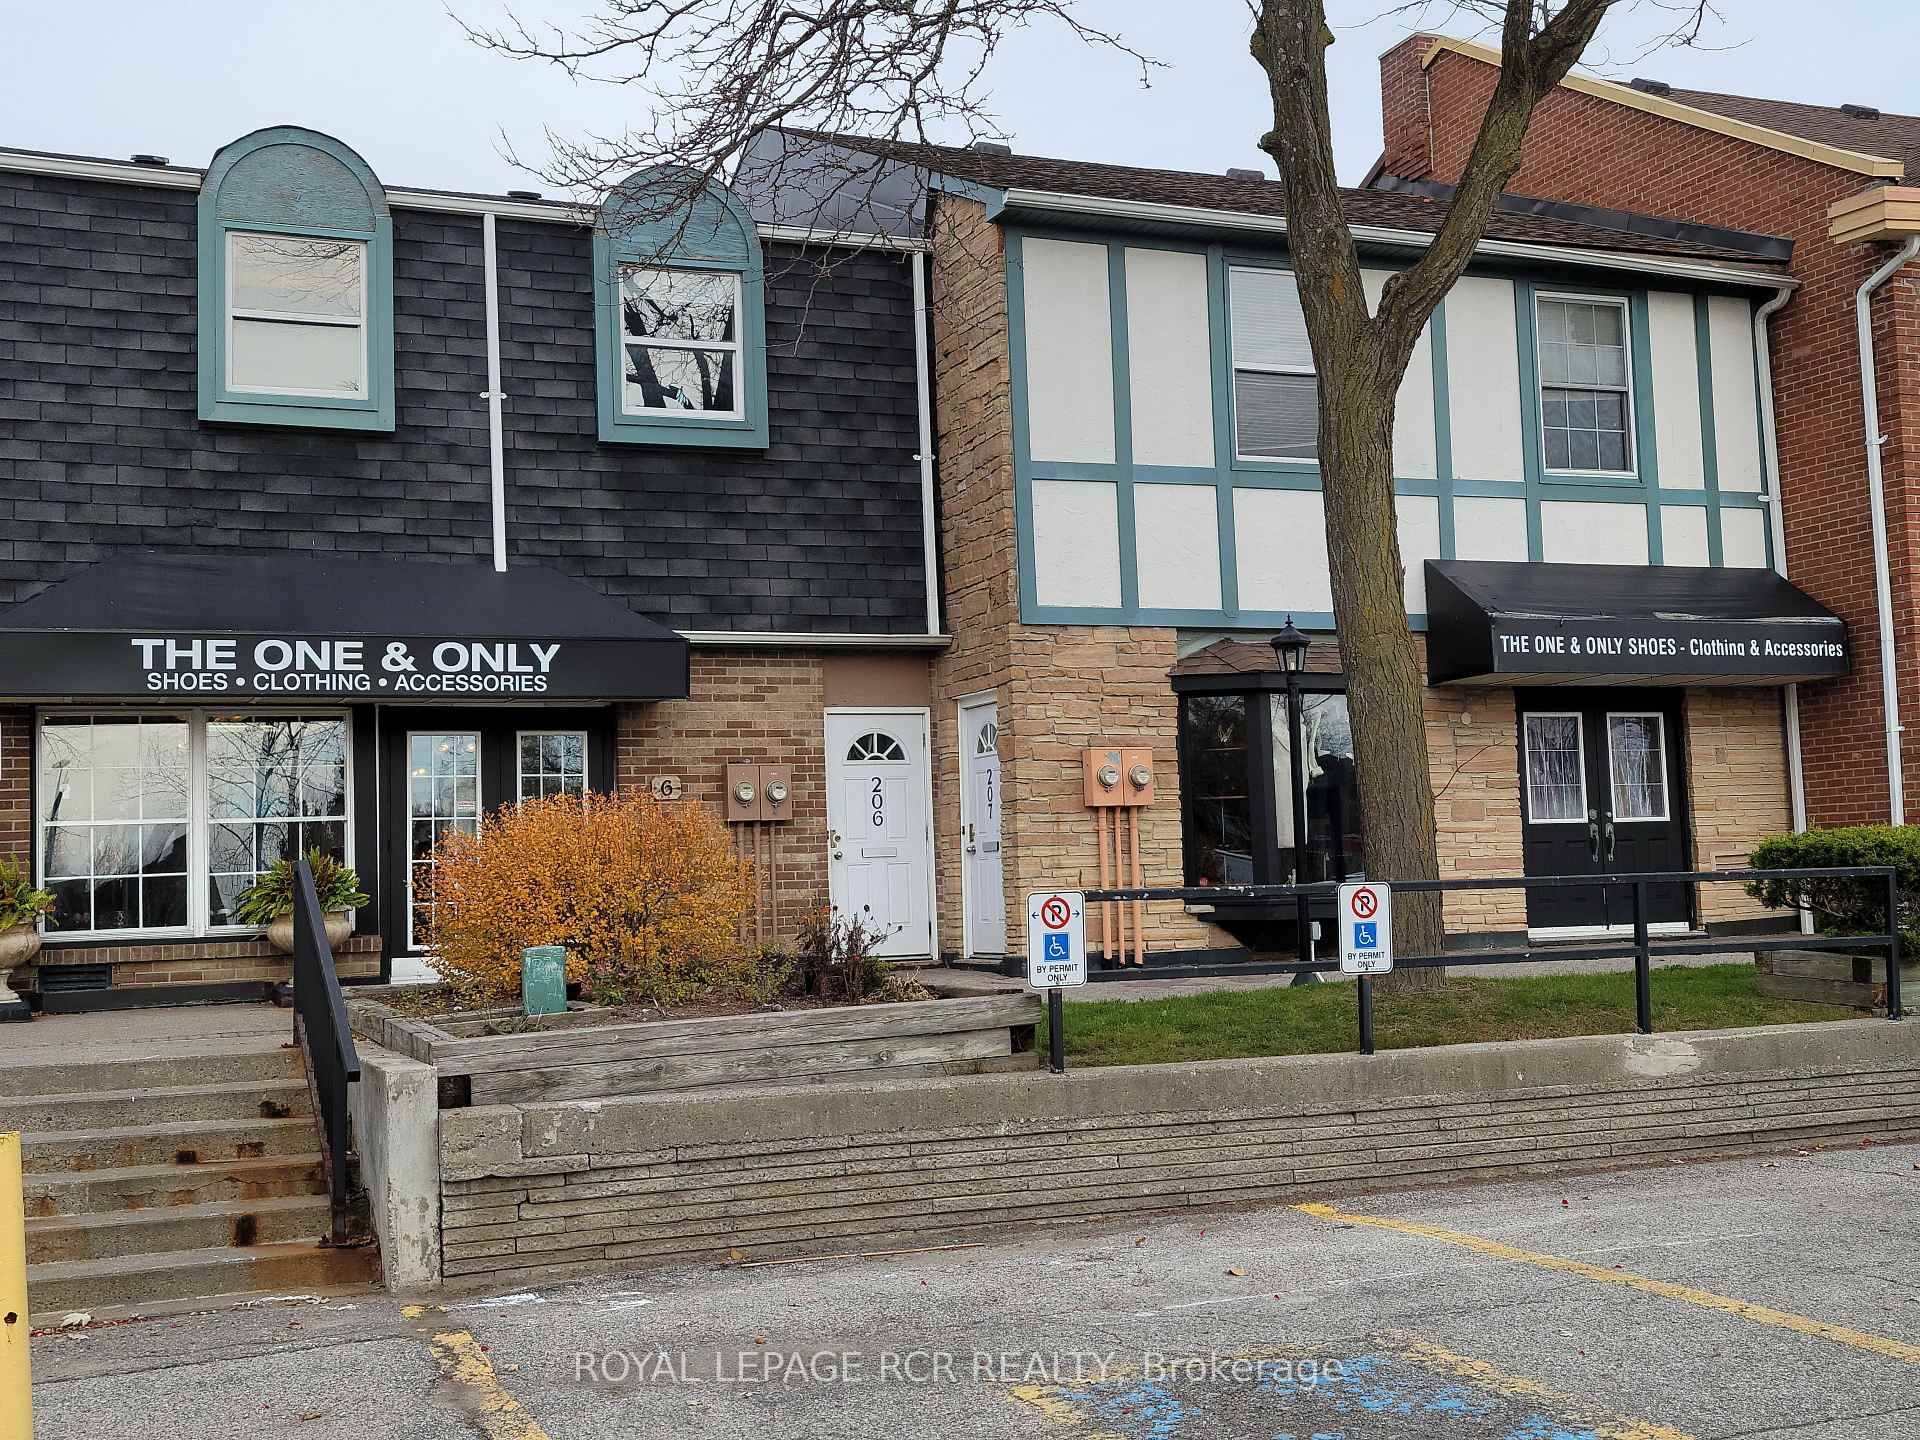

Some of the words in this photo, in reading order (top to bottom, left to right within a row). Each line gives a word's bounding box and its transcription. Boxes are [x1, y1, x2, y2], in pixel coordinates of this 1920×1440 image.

[1500, 635, 1530, 653] THE
[1535, 635, 1565, 654] ONE
[1570, 636, 1581, 654] &
[1586, 637, 1623, 654] ONLY
[1628, 637, 1677, 655] SHOES
[1750, 639, 1760, 656] &
[1765, 640, 1844, 657] Accessories
[131, 639, 237, 670] THE
[254, 640, 364, 671] ONE
[381, 641, 418, 671] &
[432, 641, 561, 673] ONLY
[146, 672, 229, 690] SHOES
[252, 672, 371, 691] CLOTHING
[394, 674, 548, 692] ACCESSORIES
[661, 779, 673, 796] 6
[986, 769, 994, 819] 207
[871, 776, 884, 827] 206
[1347, 952, 1357, 960] BY
[1358, 951, 1386, 960] PERMIT
[1357, 960, 1376, 969] ONLY
[1036, 965, 1047, 973] BY
[1049, 963, 1079, 973] PERMIT
[1047, 973, 1068, 982] ONLY
